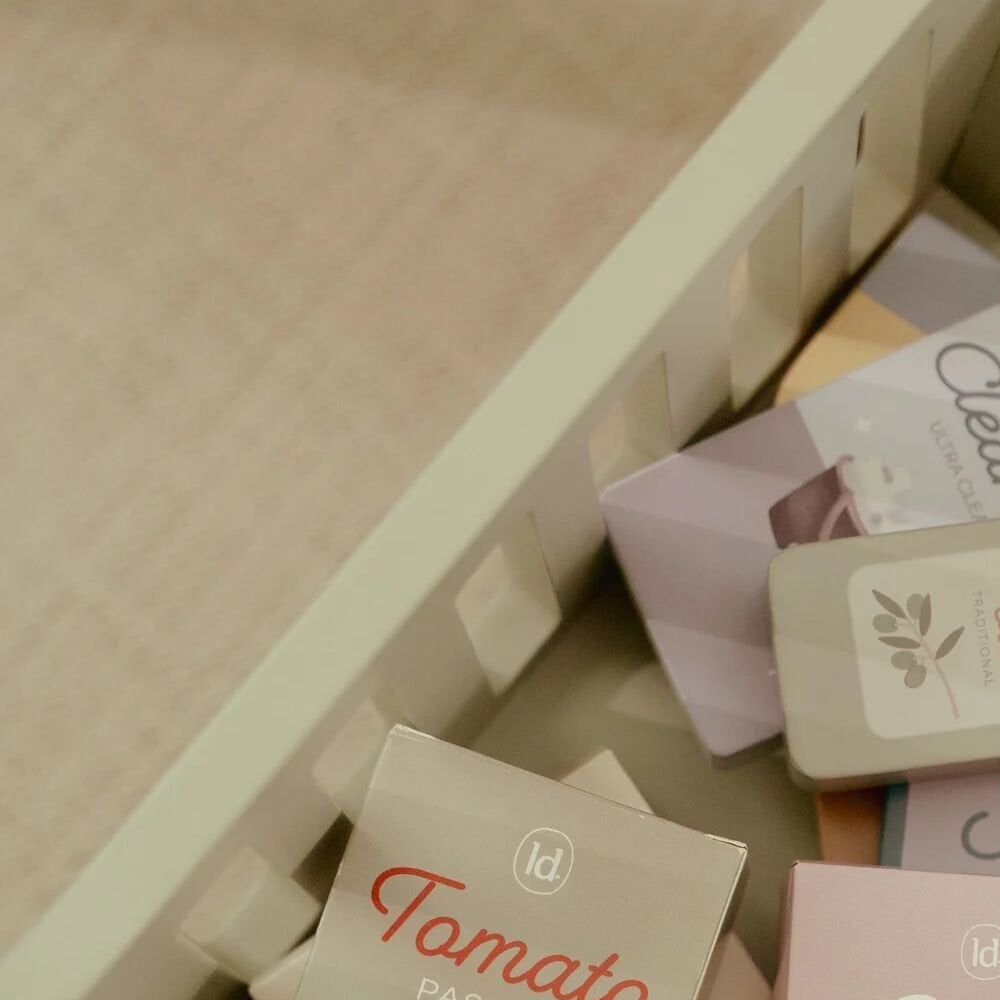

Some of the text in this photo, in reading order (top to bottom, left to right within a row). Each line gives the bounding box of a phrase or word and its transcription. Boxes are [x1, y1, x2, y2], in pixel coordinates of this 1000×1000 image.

[929, 420, 988, 520] ULTRA CLE
[971, 590, 996, 688] TRADITIONAL
